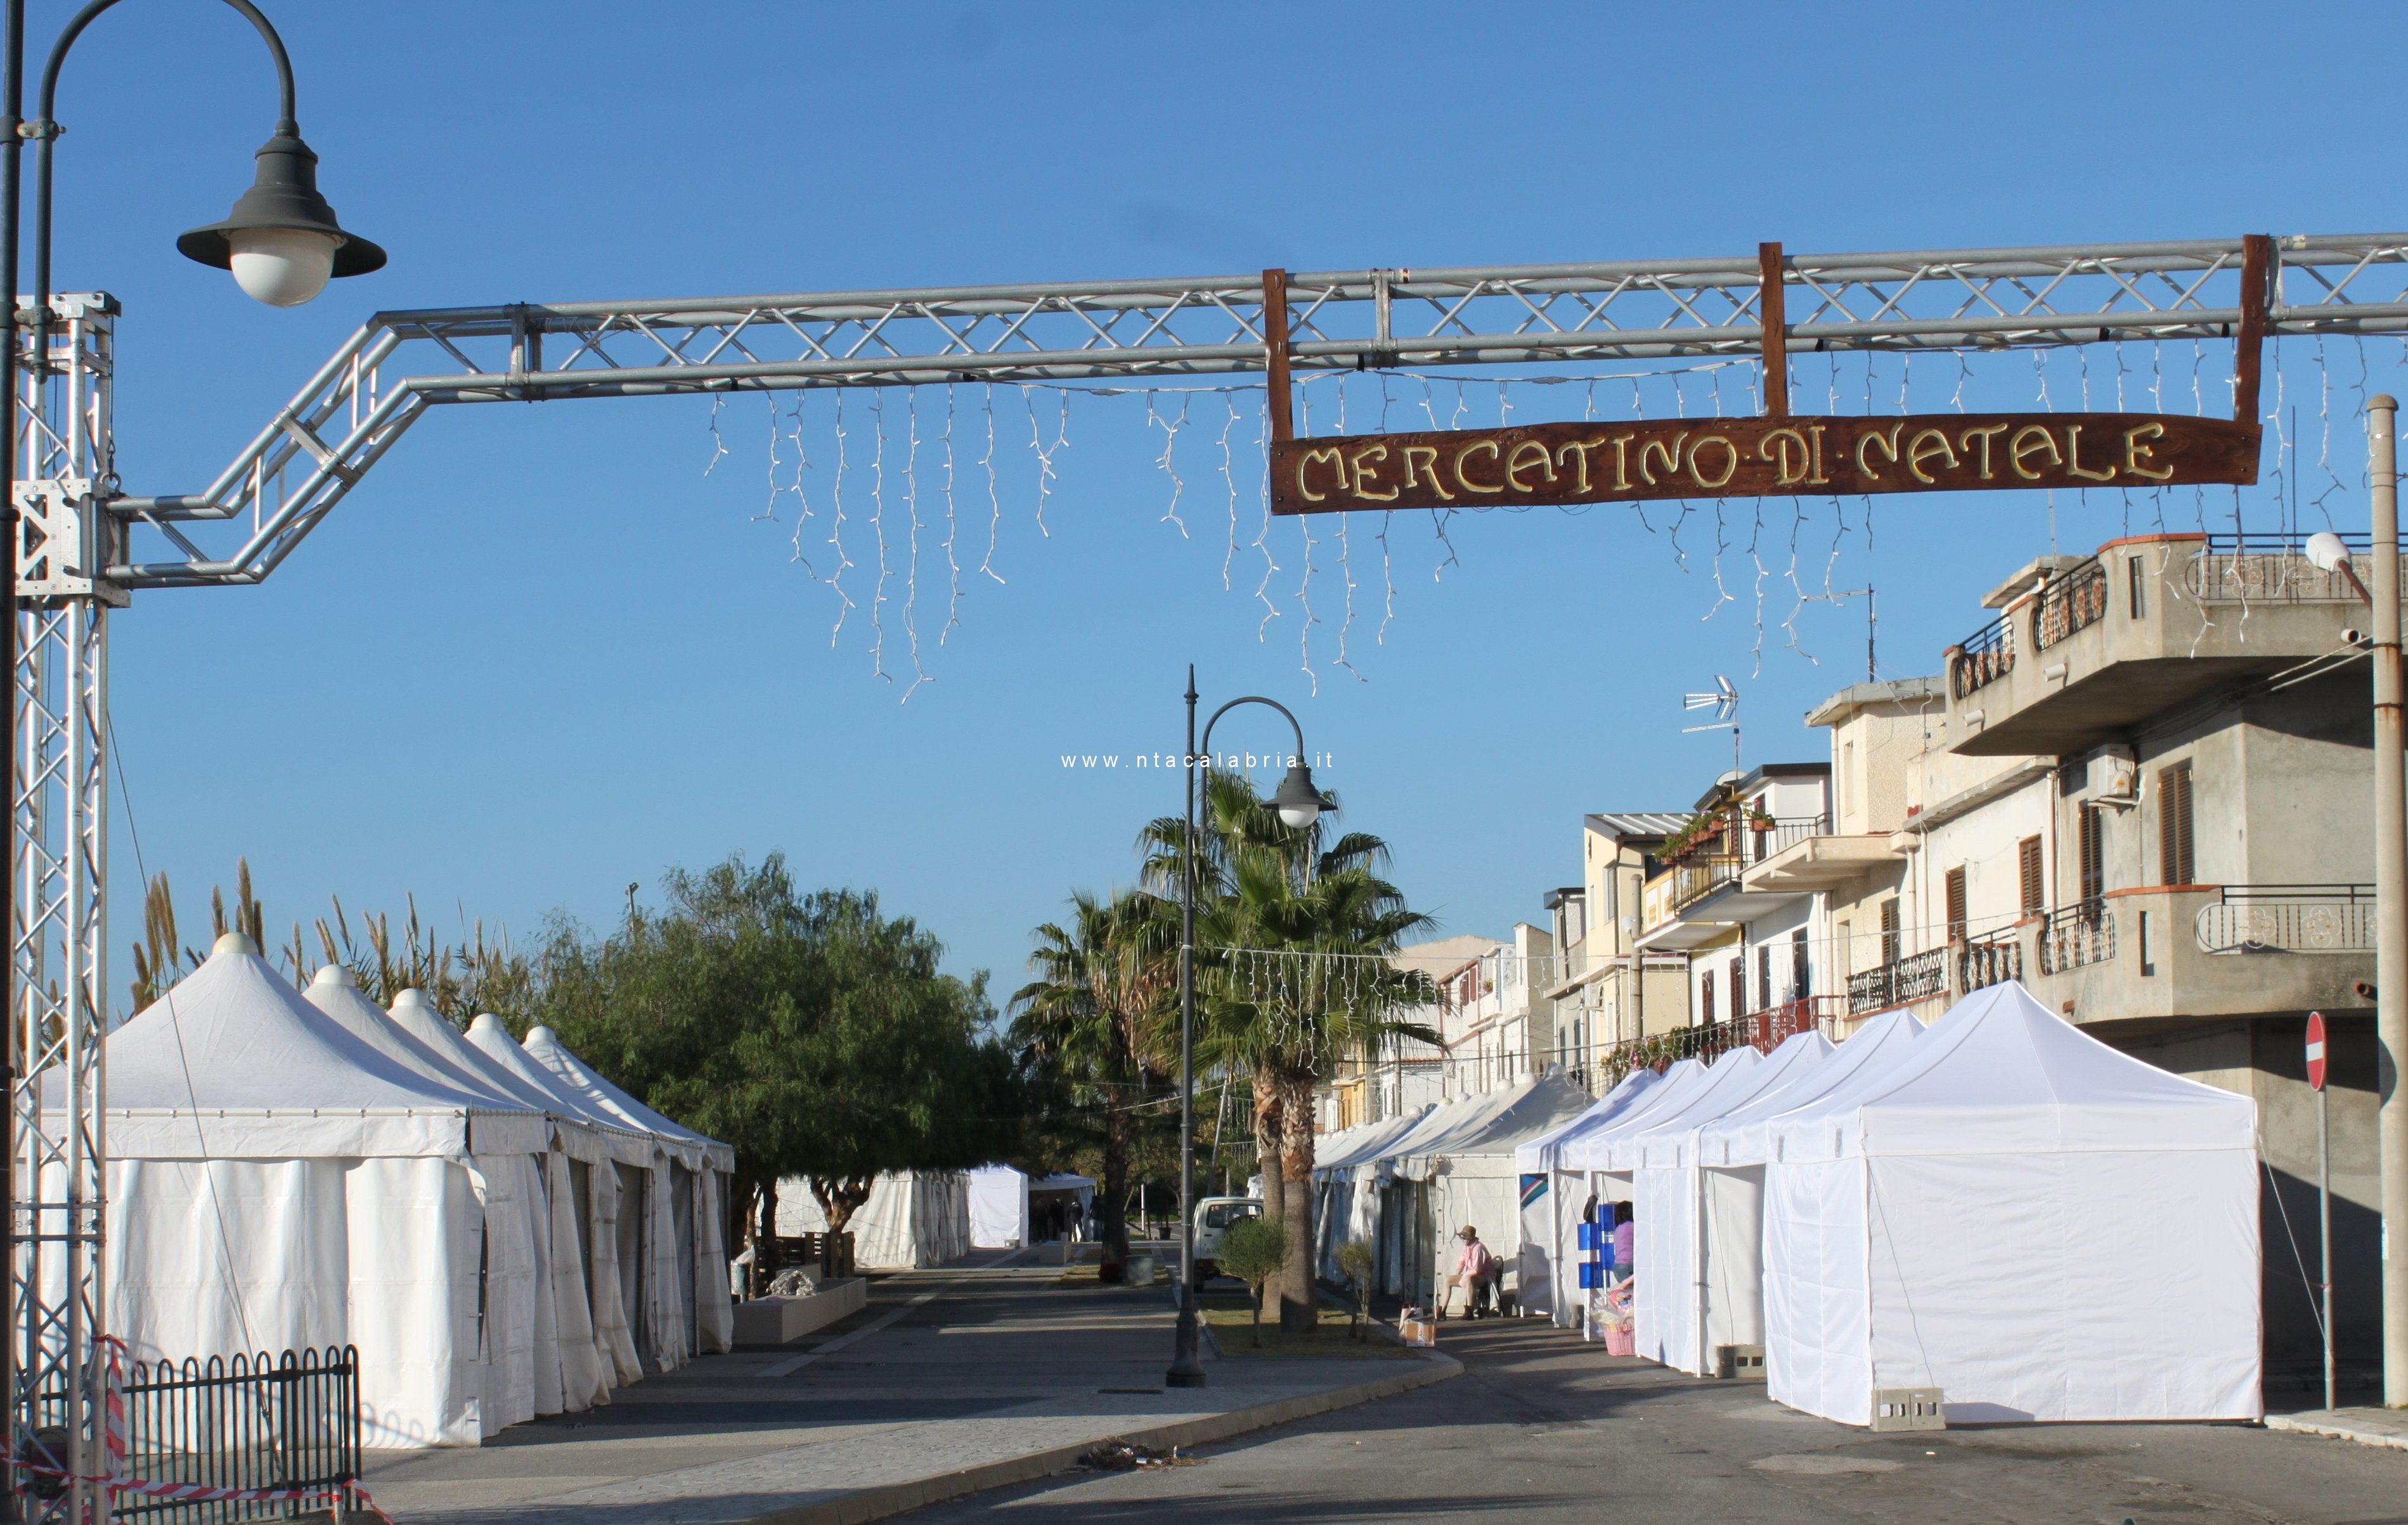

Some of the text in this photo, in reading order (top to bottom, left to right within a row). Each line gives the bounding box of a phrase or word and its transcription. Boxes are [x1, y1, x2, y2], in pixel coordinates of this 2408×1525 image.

[1297, 422, 2173, 501] MERCATINO DI NATALE
